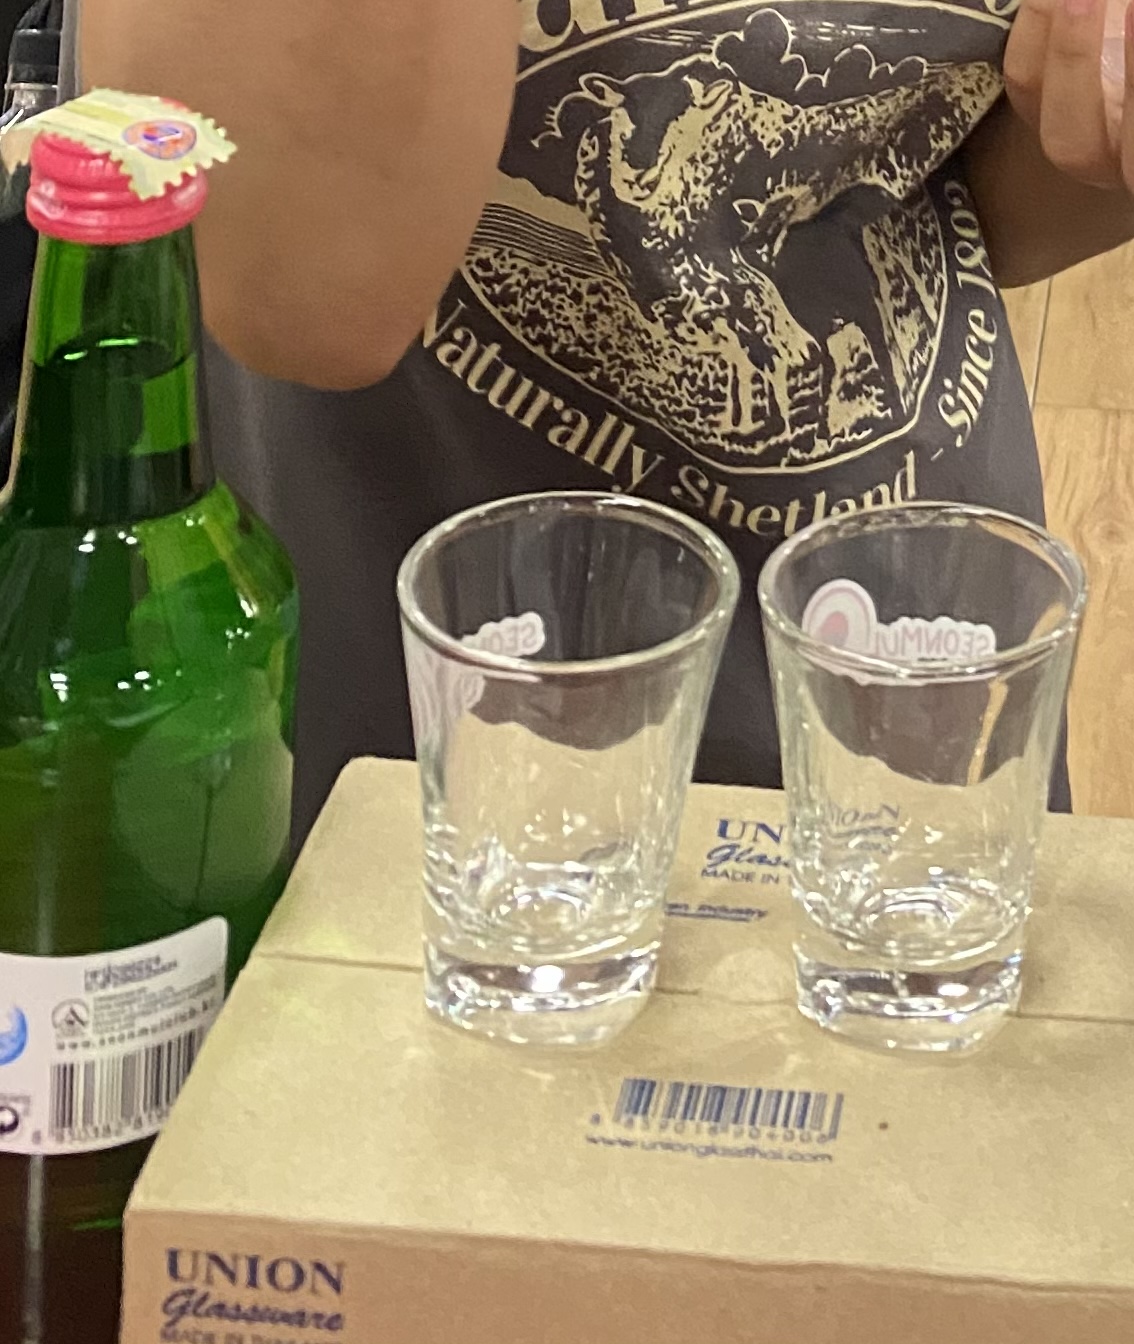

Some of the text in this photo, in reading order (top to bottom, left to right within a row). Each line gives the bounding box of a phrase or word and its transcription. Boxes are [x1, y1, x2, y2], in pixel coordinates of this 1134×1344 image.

[423, 299, 665, 492] Naturally
[670, 450, 917, 538] Shetland
[938, 308, 998, 448] Since
[166, 1248, 346, 1296] UNION
